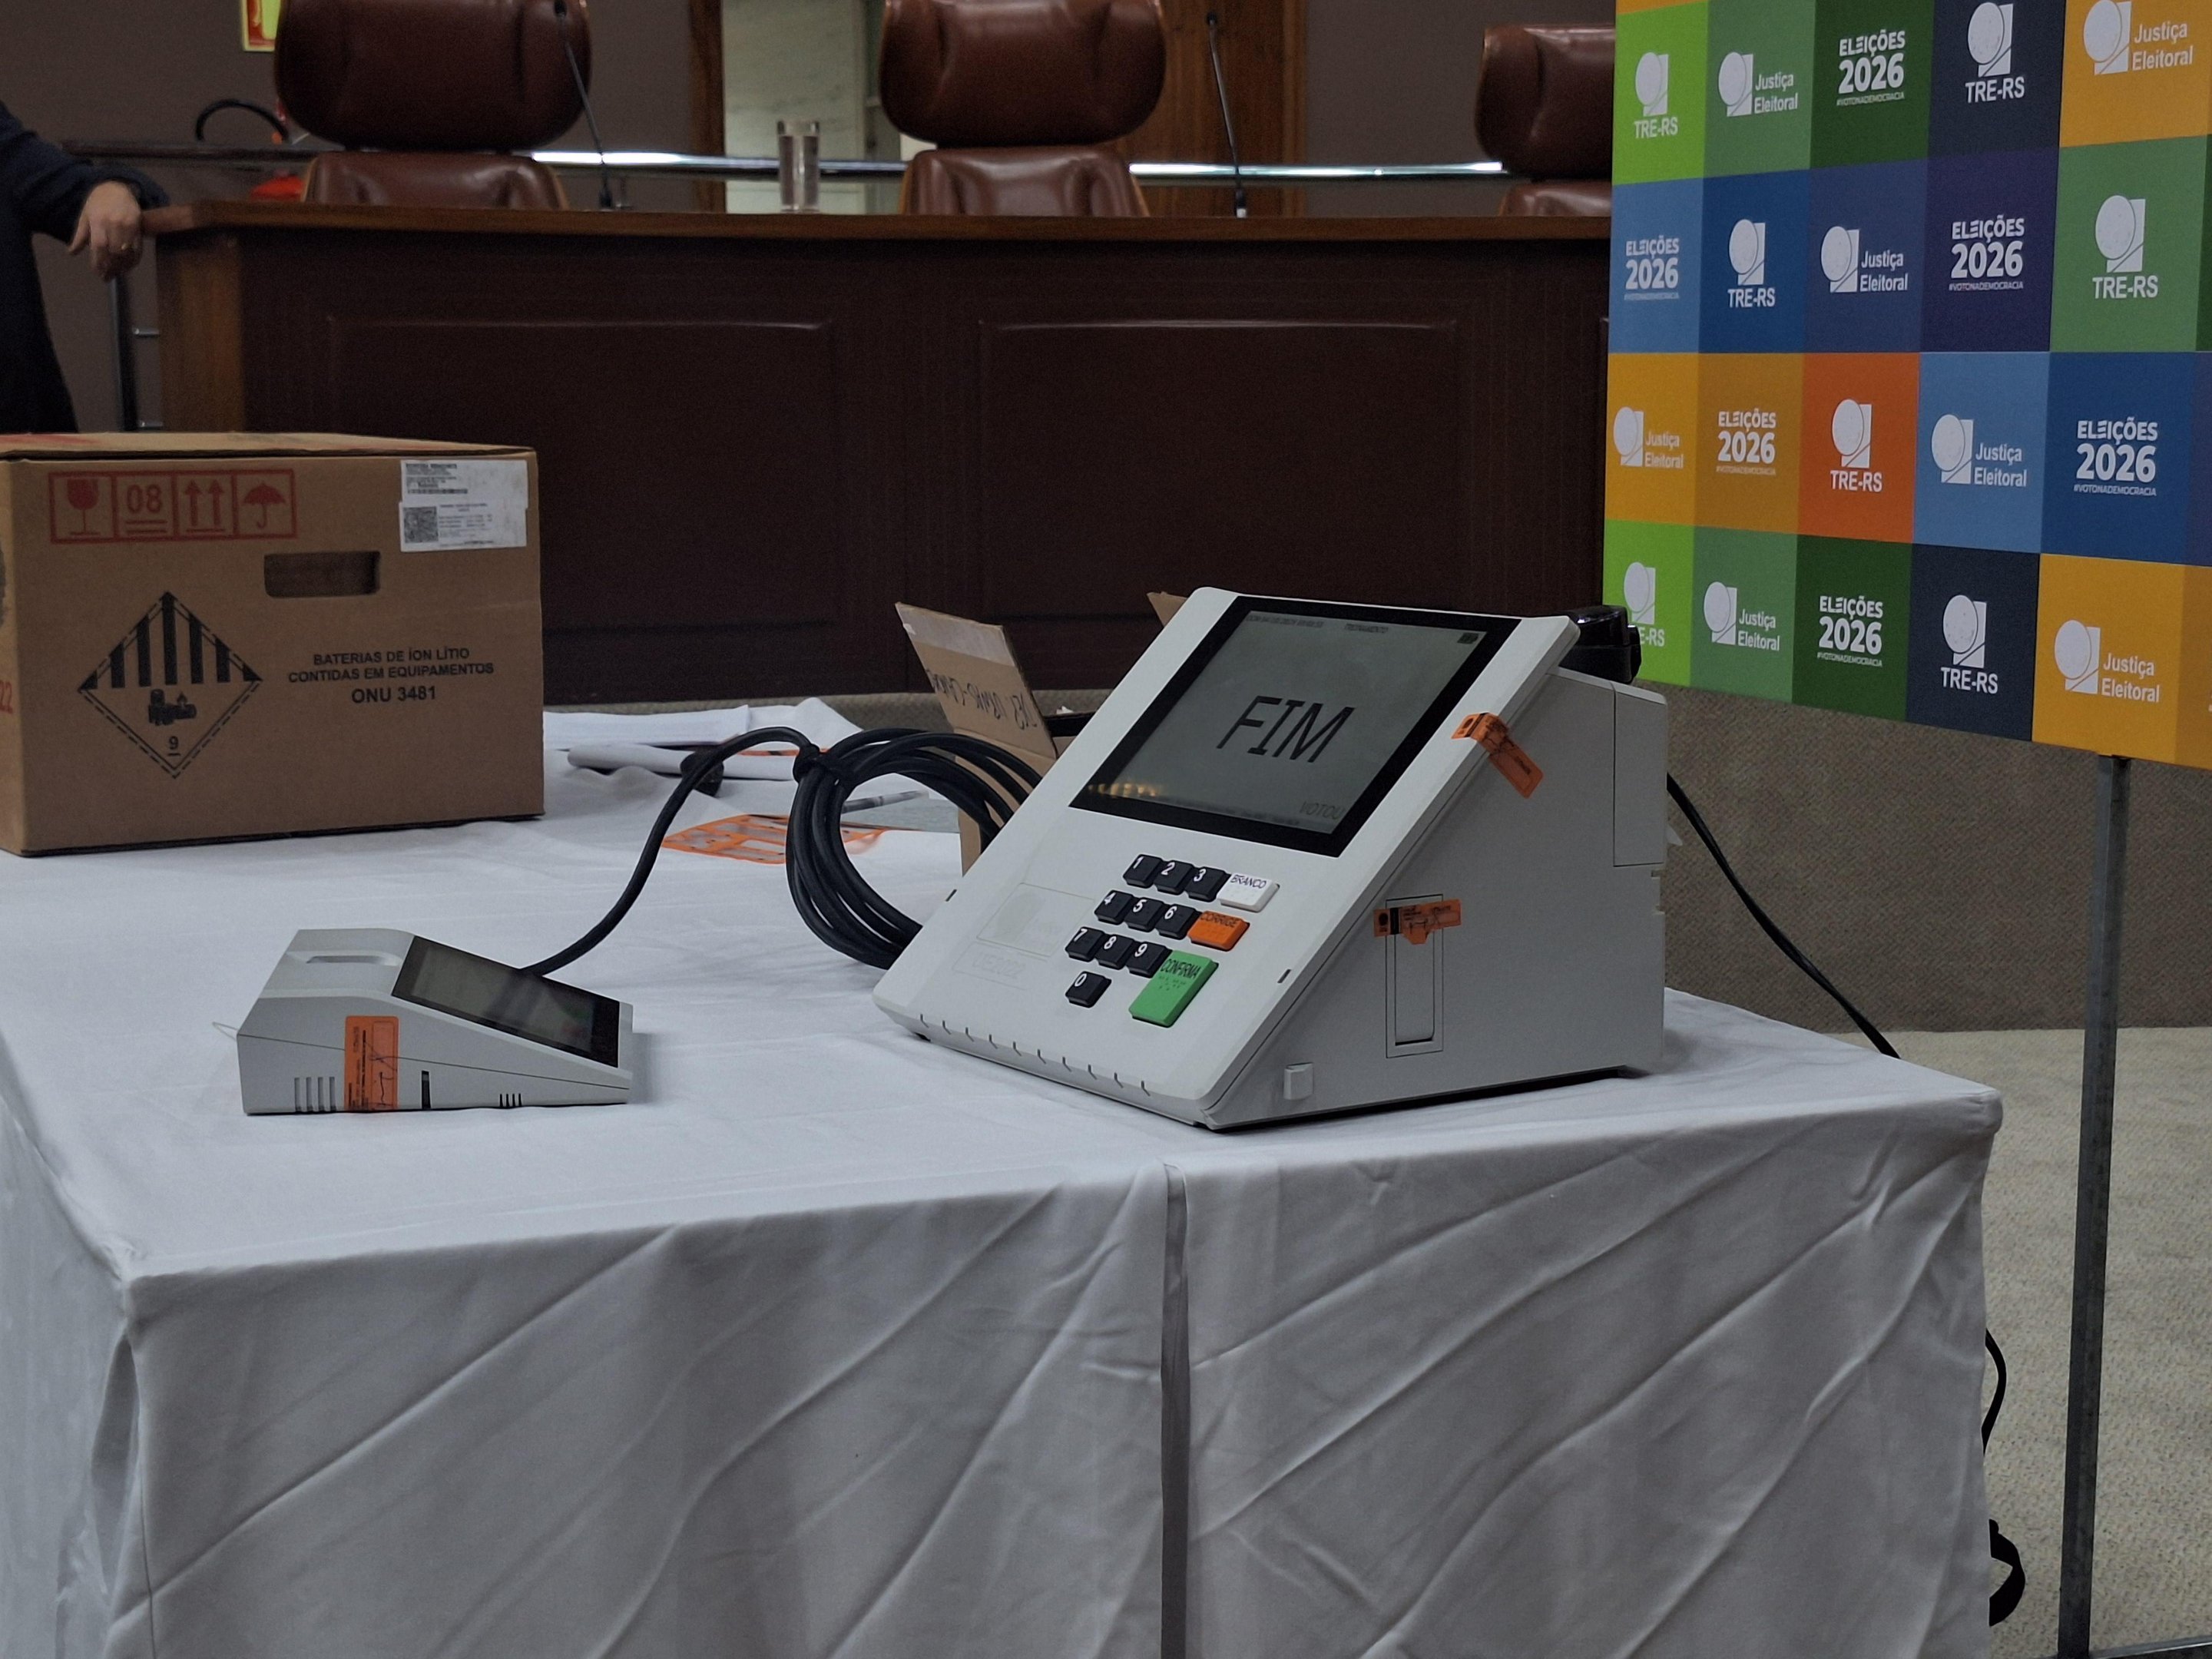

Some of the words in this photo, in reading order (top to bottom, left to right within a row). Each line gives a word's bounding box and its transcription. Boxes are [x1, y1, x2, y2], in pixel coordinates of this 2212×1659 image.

[1839, 30, 1906, 57] ELEIÇÕES
[2134, 21, 2188, 45] Justiça
[2131, 45, 2194, 72] Eleitoral
[1755, 72, 1794, 91] Justiça
[1838, 53, 1905, 94] 2026
[1965, 77, 2025, 103] TRE-RS
[1754, 93, 1798, 114] Eleitoral
[1634, 117, 1678, 138] TRE-RS
[1952, 214, 2025, 243] ELEIÇÕES
[1626, 235, 1680, 257] ELEIÇÕES
[1861, 250, 1904, 271] Justiça
[1951, 241, 2023, 279] 2026
[1625, 257, 1679, 290] 2026
[1859, 273, 1908, 293] Eleitoral
[1727, 287, 1775, 308] TRE-RS
[2092, 275, 2158, 300] TRE-RS
[1718, 408, 1777, 432] ELEIÇÕES
[2077, 417, 2158, 445] ELEIÇÕES
[1645, 432, 1681, 447] Justiça
[1717, 431, 1776, 464] 2026
[1644, 454, 1684, 469] Eleitoral
[1975, 443, 2022, 465] Justiça
[2076, 443, 2156, 482] 2026
[1830, 470, 1883, 492] TRE-RS
[1974, 467, 2027, 487] Eleitoral
[126, 485, 162, 514] 08
[1820, 595, 1883, 620] ELEIÇÕES
[1738, 609, 1776, 631] Justiça
[1637, 626, 1665, 647] E-RS
[1737, 631, 1780, 651] Eleitoral
[1819, 616, 1882, 655] 2026
[313, 652, 382, 665] BATERIAS
[386, 651, 405, 663] DE
[436, 646, 470, 660] LÍTIO
[2103, 653, 2154, 679] Justiça
[289, 668, 359, 683] CONTIDAS
[365, 667, 383, 680] EM
[389, 663, 494, 678] EQUIPAMENTOS
[1941, 667, 1998, 694] TRE-RS
[352, 687, 391, 704] ONU
[398, 686, 435, 702] 3481
[2101, 678, 2160, 703] Eleitoral
[1217, 696, 1356, 763] FIM
[169, 736, 179, 750] 9
[1133, 856, 1144, 869] 1
[1161, 862, 1175, 875] 2
[1194, 869, 1207, 882] 3
[1230, 874, 1267, 889] BRANCO
[1104, 892, 1116, 906] 4
[1133, 899, 1147, 912] 5
[1164, 906, 1177, 919] 6
[1073, 929, 1088, 942] 7
[1104, 935, 1117, 949] 8
[1134, 943, 1147, 957] 9
[1075, 973, 1087, 986] 0
[1160, 959, 1202, 979] CONFIRMA
